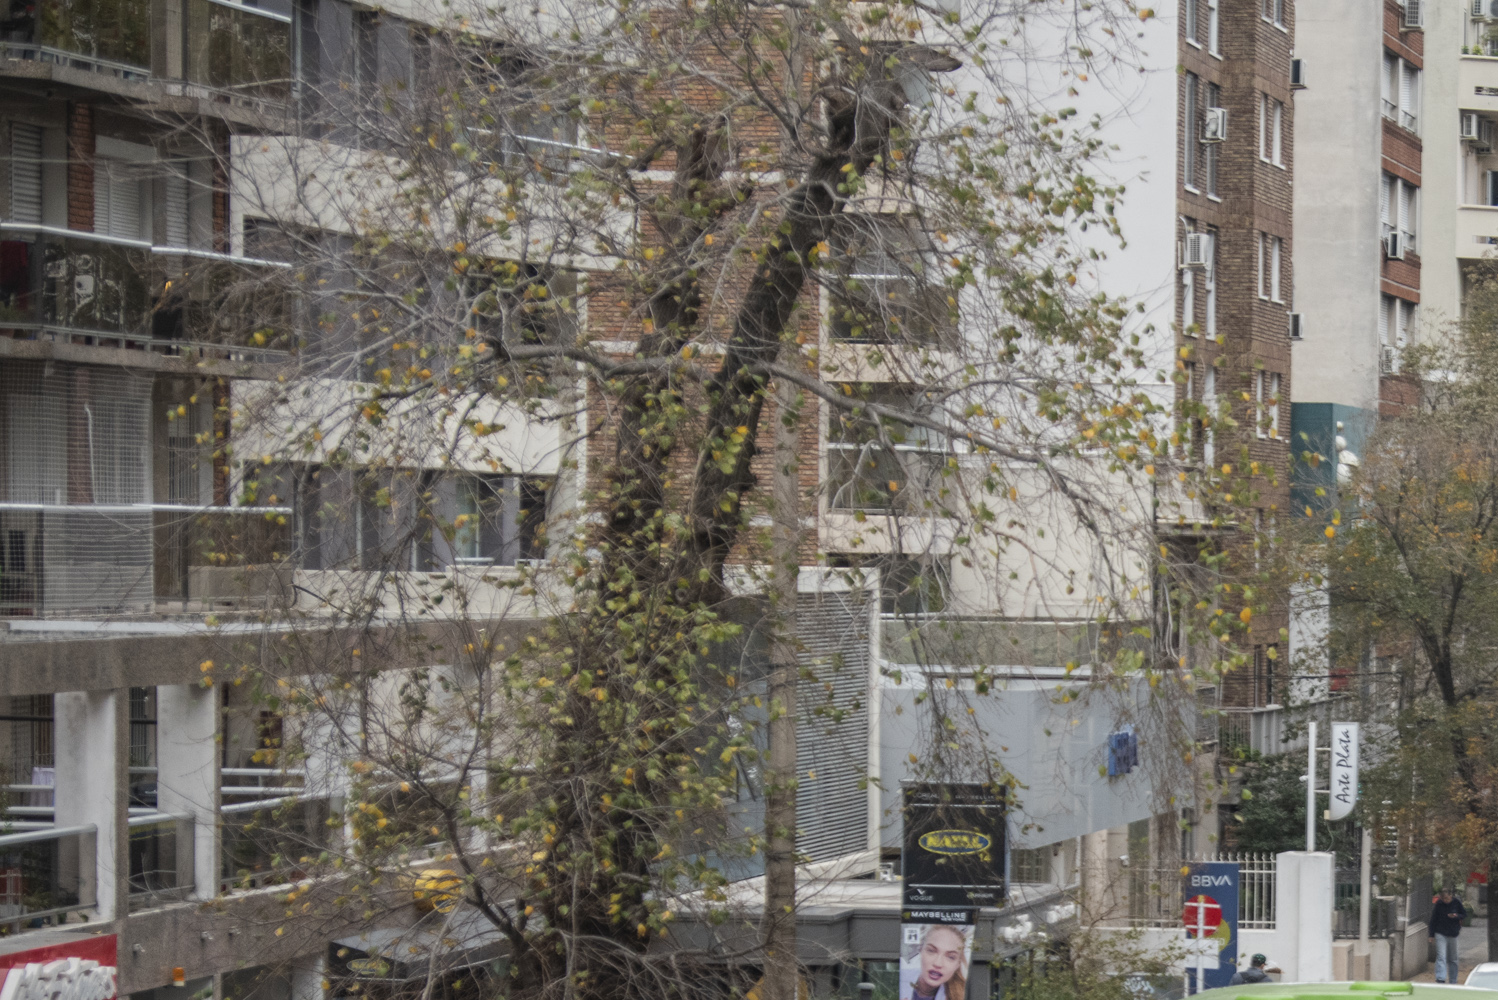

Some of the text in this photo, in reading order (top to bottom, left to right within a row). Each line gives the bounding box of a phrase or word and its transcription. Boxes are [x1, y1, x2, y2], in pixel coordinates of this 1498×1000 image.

[1335, 729, 1352, 804] Arte Plata
[1191, 875, 1232, 887] BBVA
[911, 911, 966, 919] MAYBELLINE
